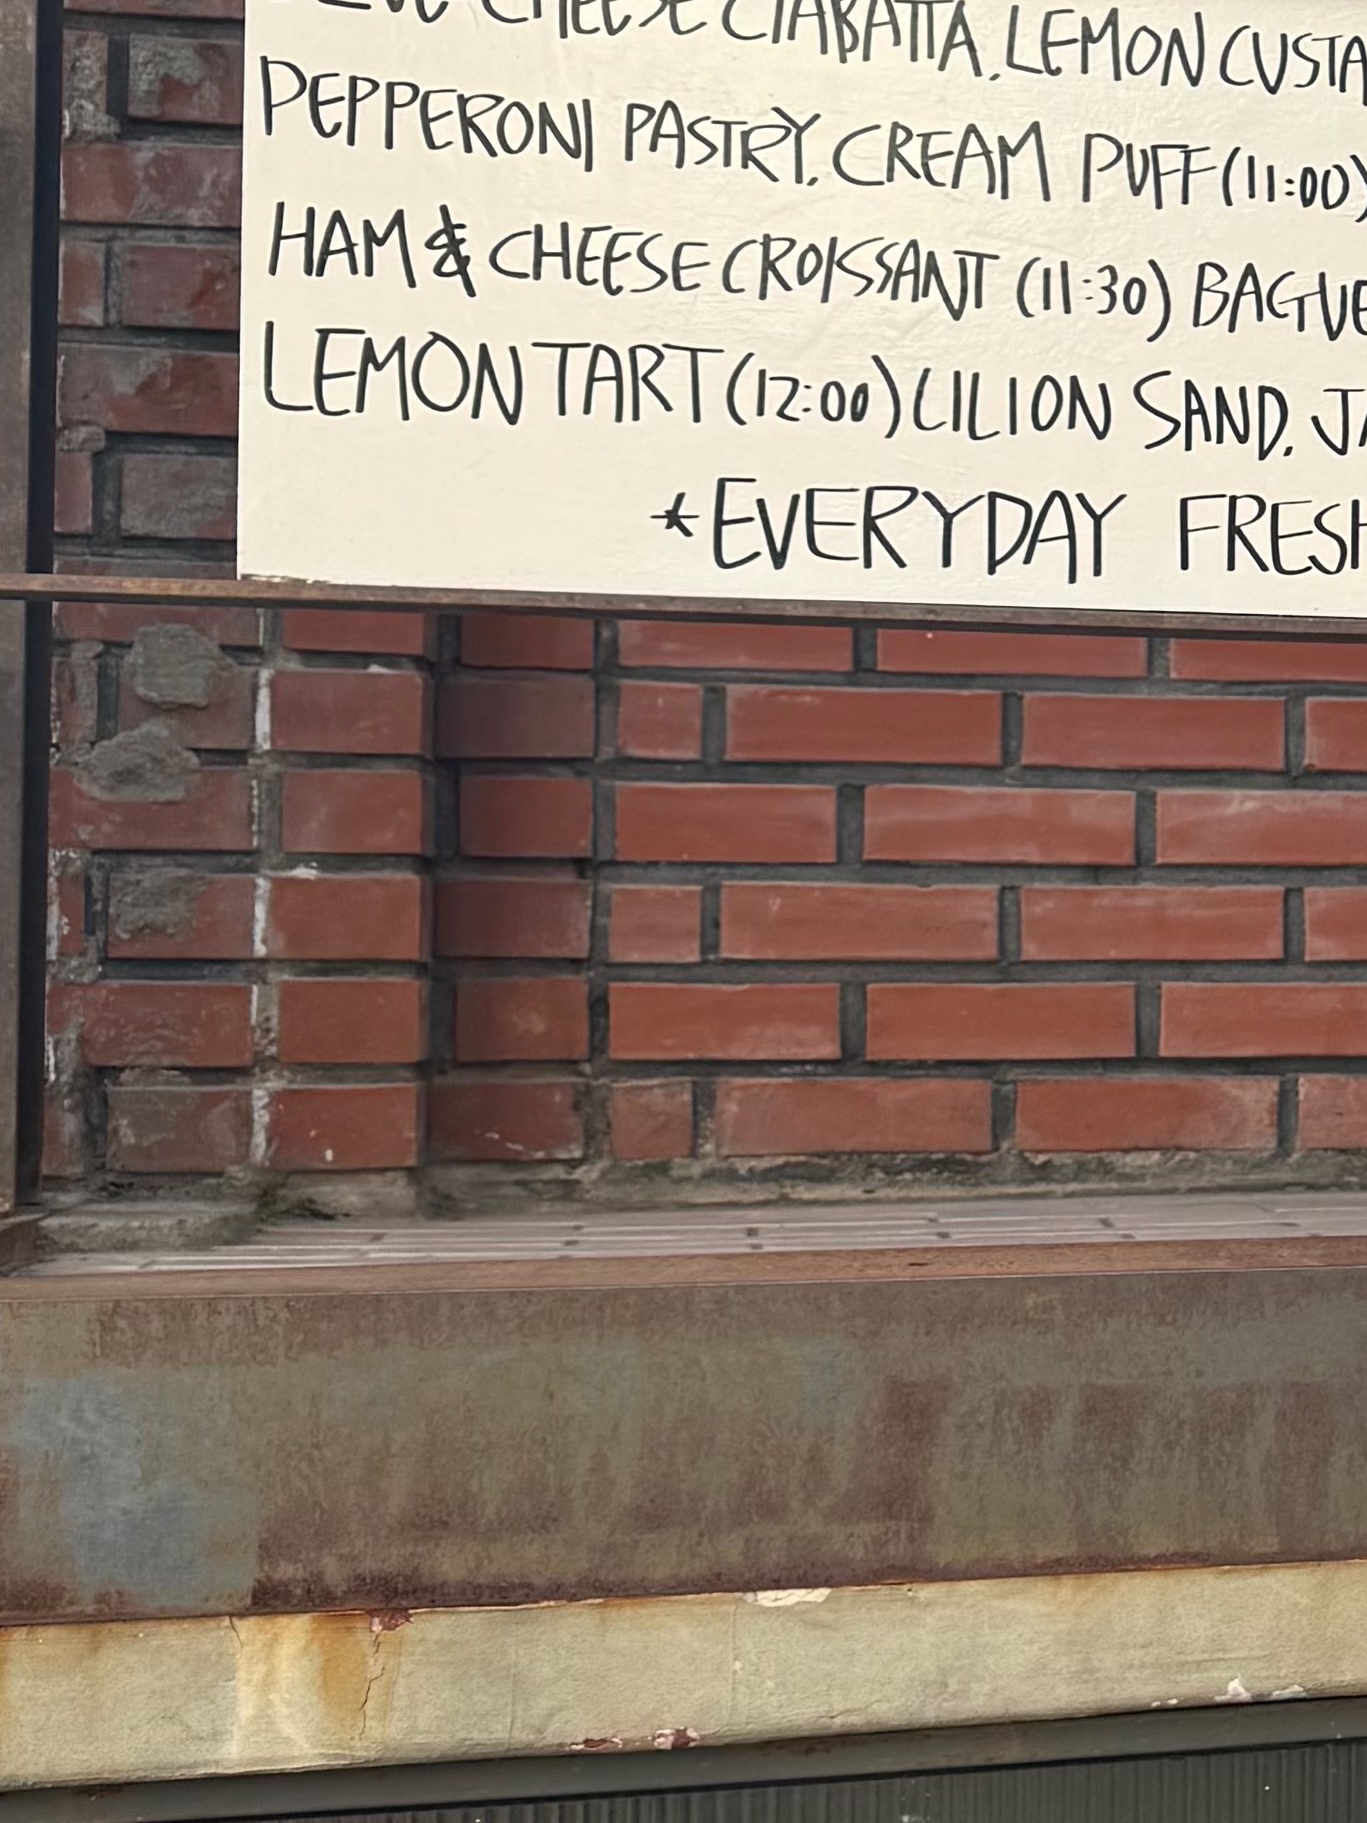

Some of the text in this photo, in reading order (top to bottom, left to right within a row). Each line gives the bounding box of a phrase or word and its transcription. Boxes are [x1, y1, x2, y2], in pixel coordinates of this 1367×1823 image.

[1005, 3, 1206, 89] LEMON
[258, 54, 595, 174] PEPPERONI
[831, 119, 1052, 204] CREAM
[267, 200, 418, 290] HAM
[487, 220, 712, 298] CHEESE
[721, 232, 1002, 323] CROISSANT
[1015, 255, 1173, 344] (11:30)
[712, 476, 1129, 586] EVERYDAY
